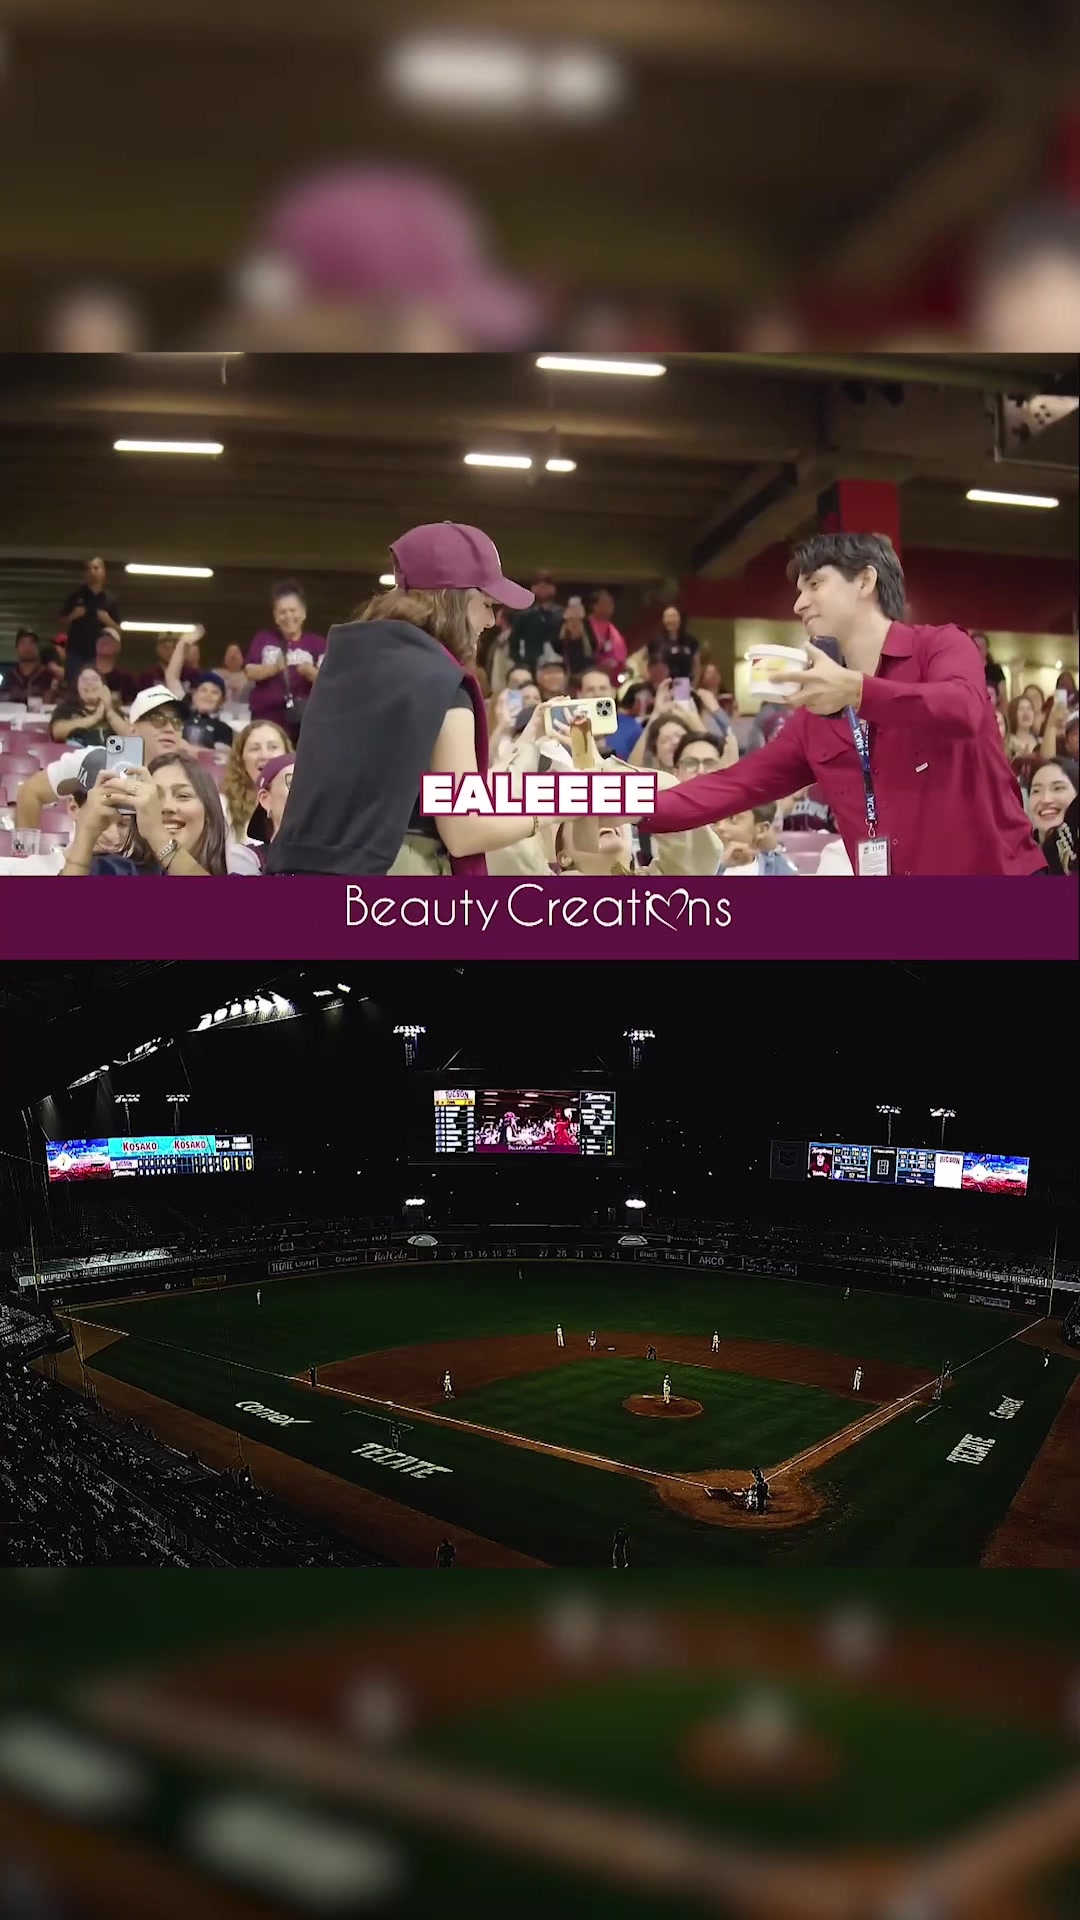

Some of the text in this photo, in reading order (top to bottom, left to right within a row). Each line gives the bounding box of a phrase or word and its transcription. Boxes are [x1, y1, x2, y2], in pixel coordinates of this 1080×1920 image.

[123, 1142, 157, 1151] KOSAKO
[174, 1141, 206, 1149] KOSAKO
[223, 1157, 230, 1171] 0
[234, 1157, 239, 1171] 1
[246, 1157, 252, 1171] 0
[699, 1256, 724, 1265] ARCO
[946, 1433, 996, 1465] TECATE
[351, 1443, 453, 1479] TECATE
